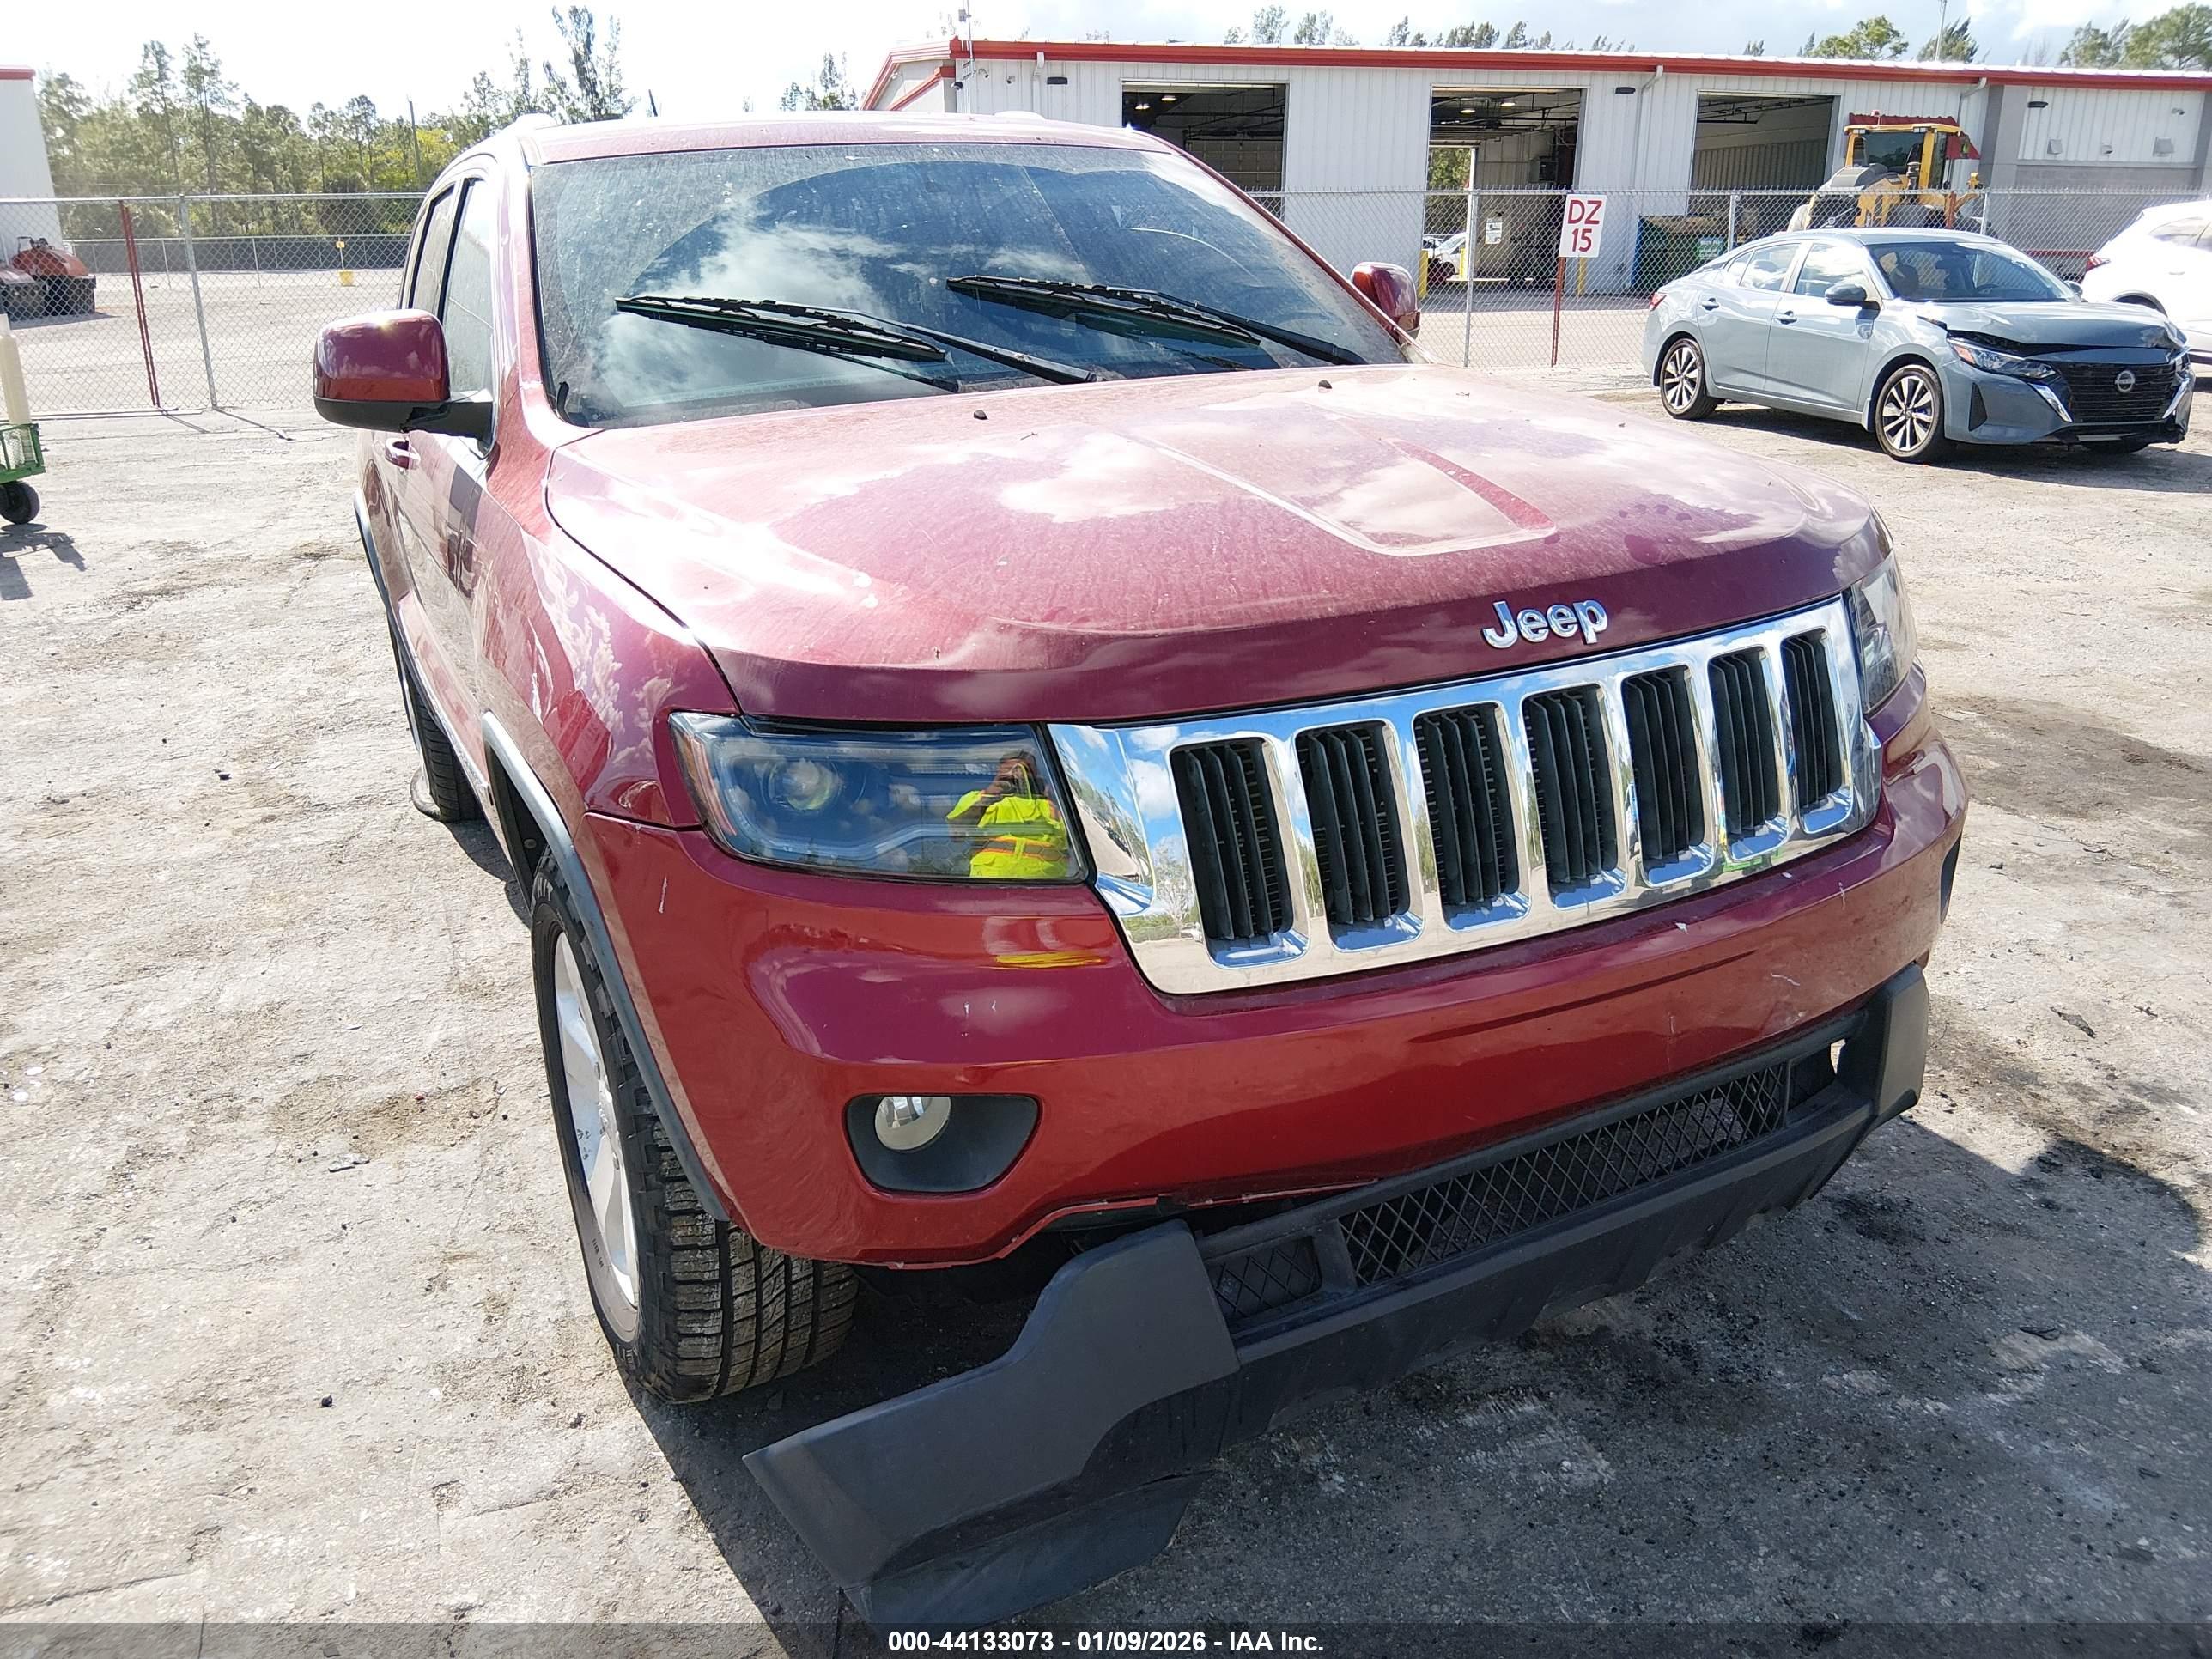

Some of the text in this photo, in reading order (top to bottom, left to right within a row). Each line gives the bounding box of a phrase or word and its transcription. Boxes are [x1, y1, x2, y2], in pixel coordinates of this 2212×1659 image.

[1567, 199, 1602, 225] DZ
[1571, 228, 1593, 252] 15
[1482, 599, 1608, 649] Jeep
